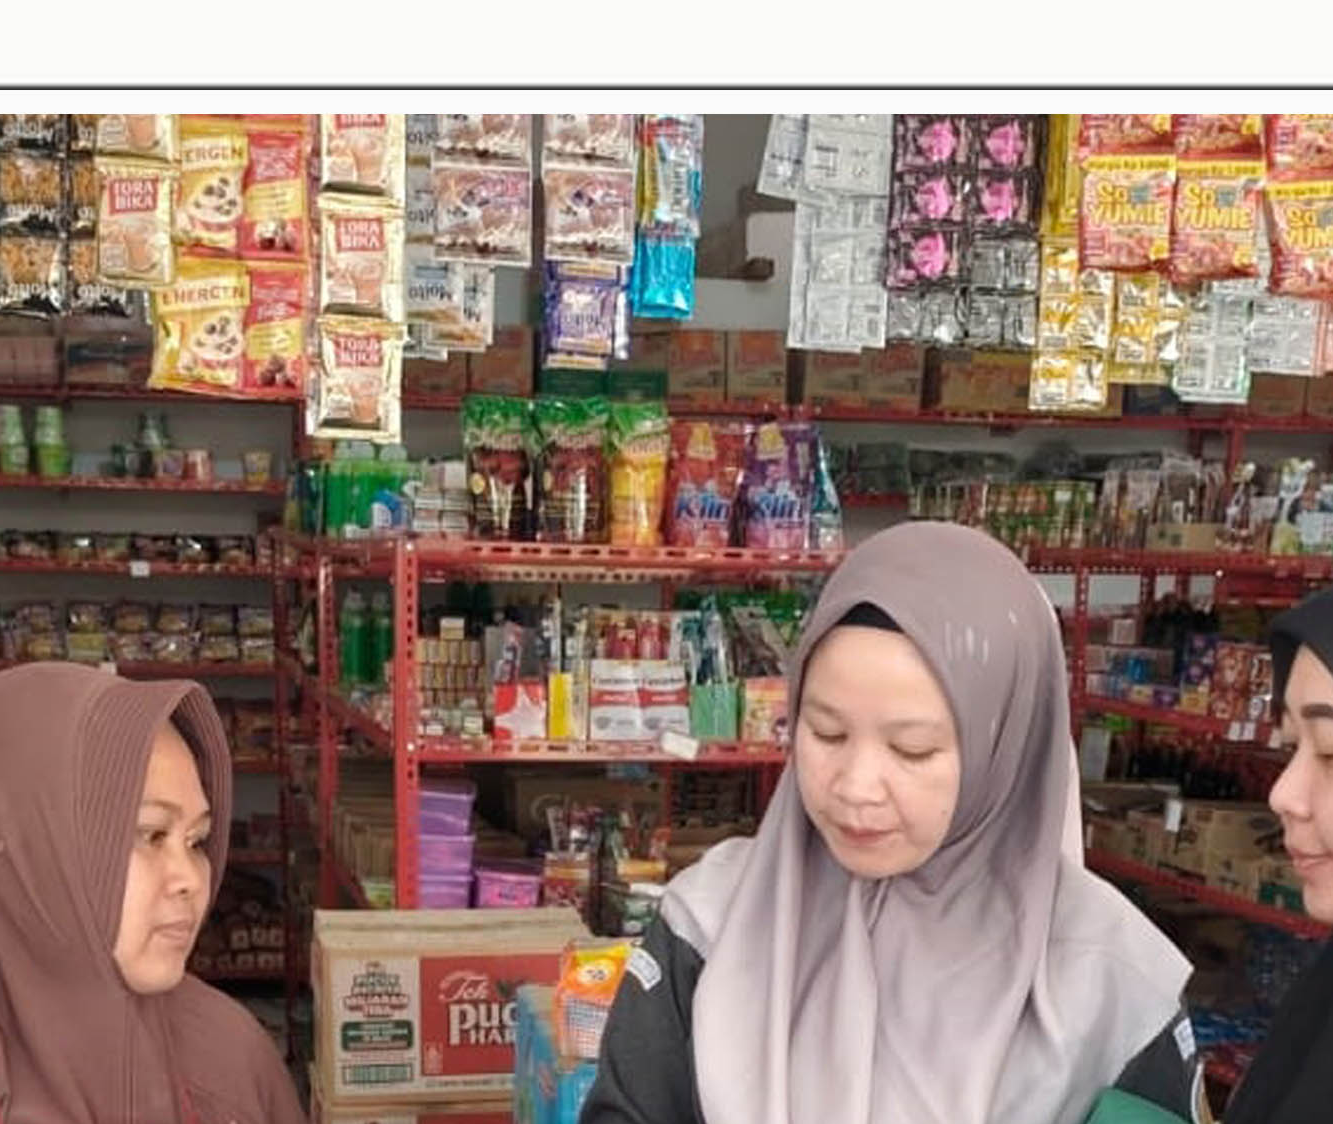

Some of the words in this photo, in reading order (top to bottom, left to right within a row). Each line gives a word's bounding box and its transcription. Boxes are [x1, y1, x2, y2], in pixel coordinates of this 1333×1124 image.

[185, 144, 244, 162] ERGEN
[1098, 181, 1128, 203] So
[1187, 183, 1215, 205] So
[1090, 203, 1165, 226] YUMIE
[1177, 207, 1252, 230] YUMIE
[162, 286, 244, 305] ENERGEN
